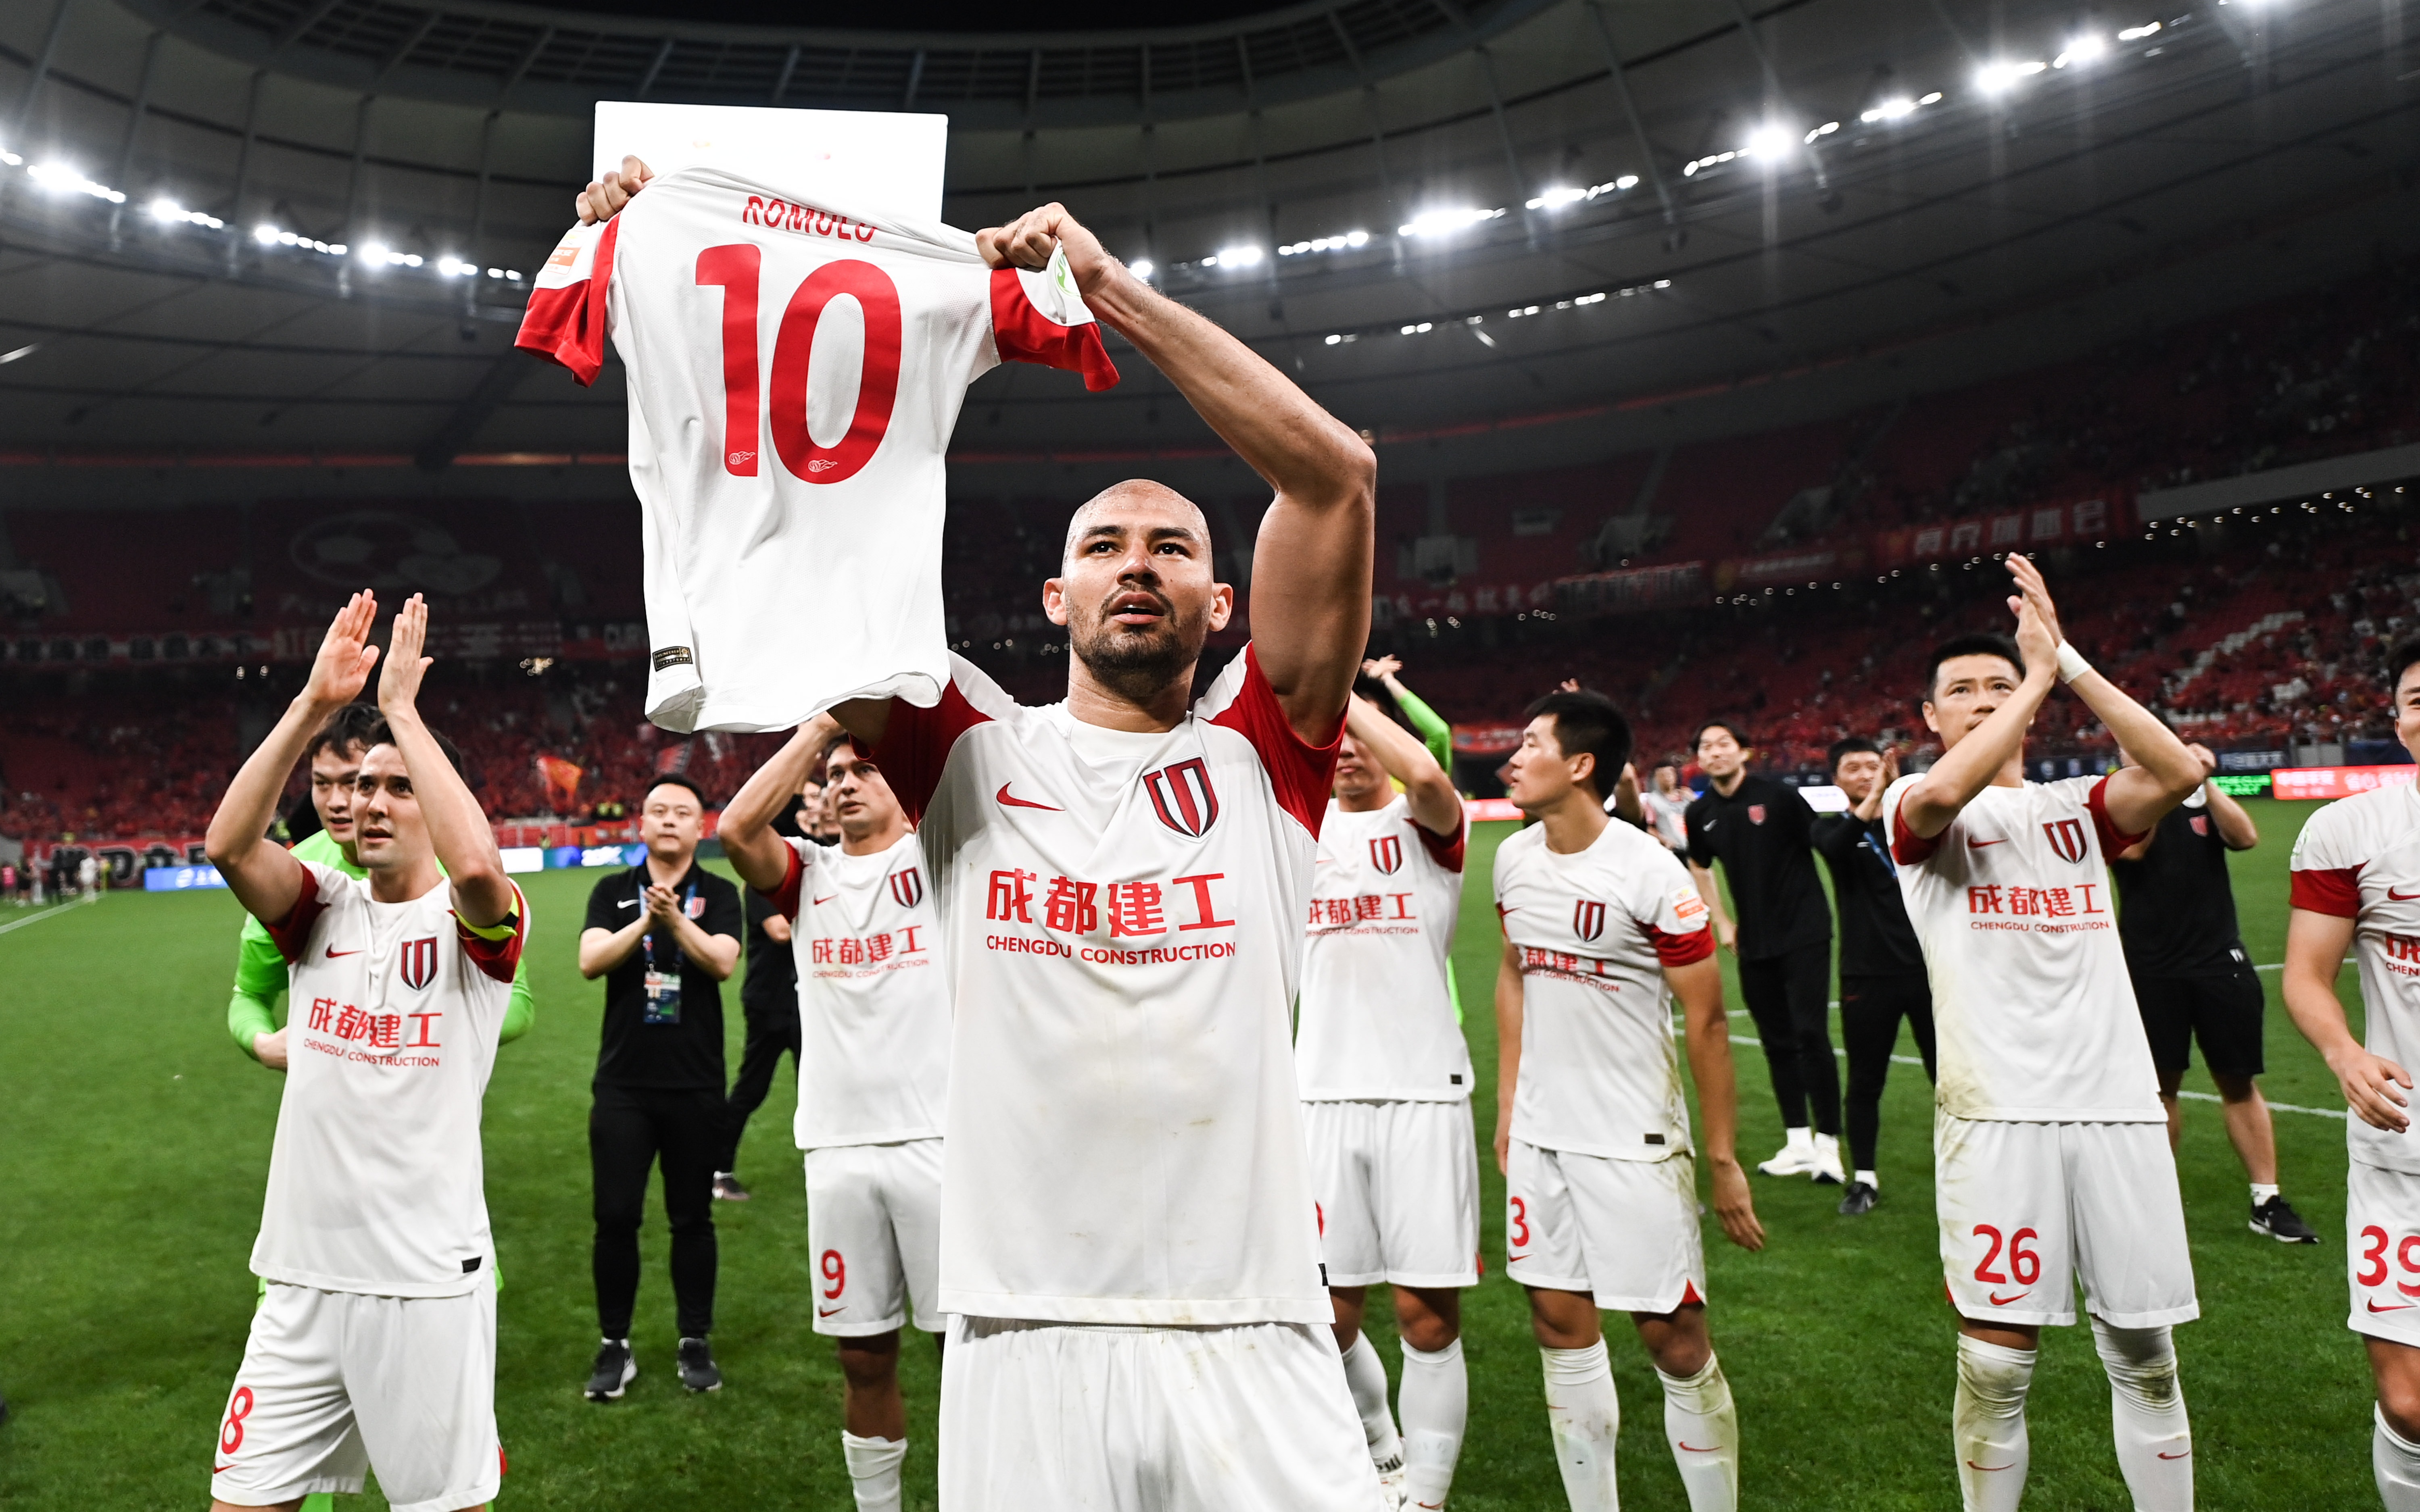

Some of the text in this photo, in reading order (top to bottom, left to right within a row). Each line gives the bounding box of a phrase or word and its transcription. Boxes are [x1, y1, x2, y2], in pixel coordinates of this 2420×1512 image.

[696, 244, 901, 483] 10
[986, 868, 1235, 937] 成都建工
[1968, 884, 2104, 918] 成都建工
[1971, 921, 2030, 931] CHENGDU
[812, 925, 927, 964] 成都建工
[987, 935, 1236, 964] CHENGDU CONSTRUCTION
[309, 998, 442, 1048] 成都建工
[303, 1038, 440, 1067] CHENGDU CONSTRUCTION
[1510, 1196, 1529, 1247] 3
[822, 1250, 845, 1299] 9
[1973, 1224, 2040, 1285] 26
[2357, 1225, 2420, 1297] 39
[222, 1386, 254, 1454] 8
